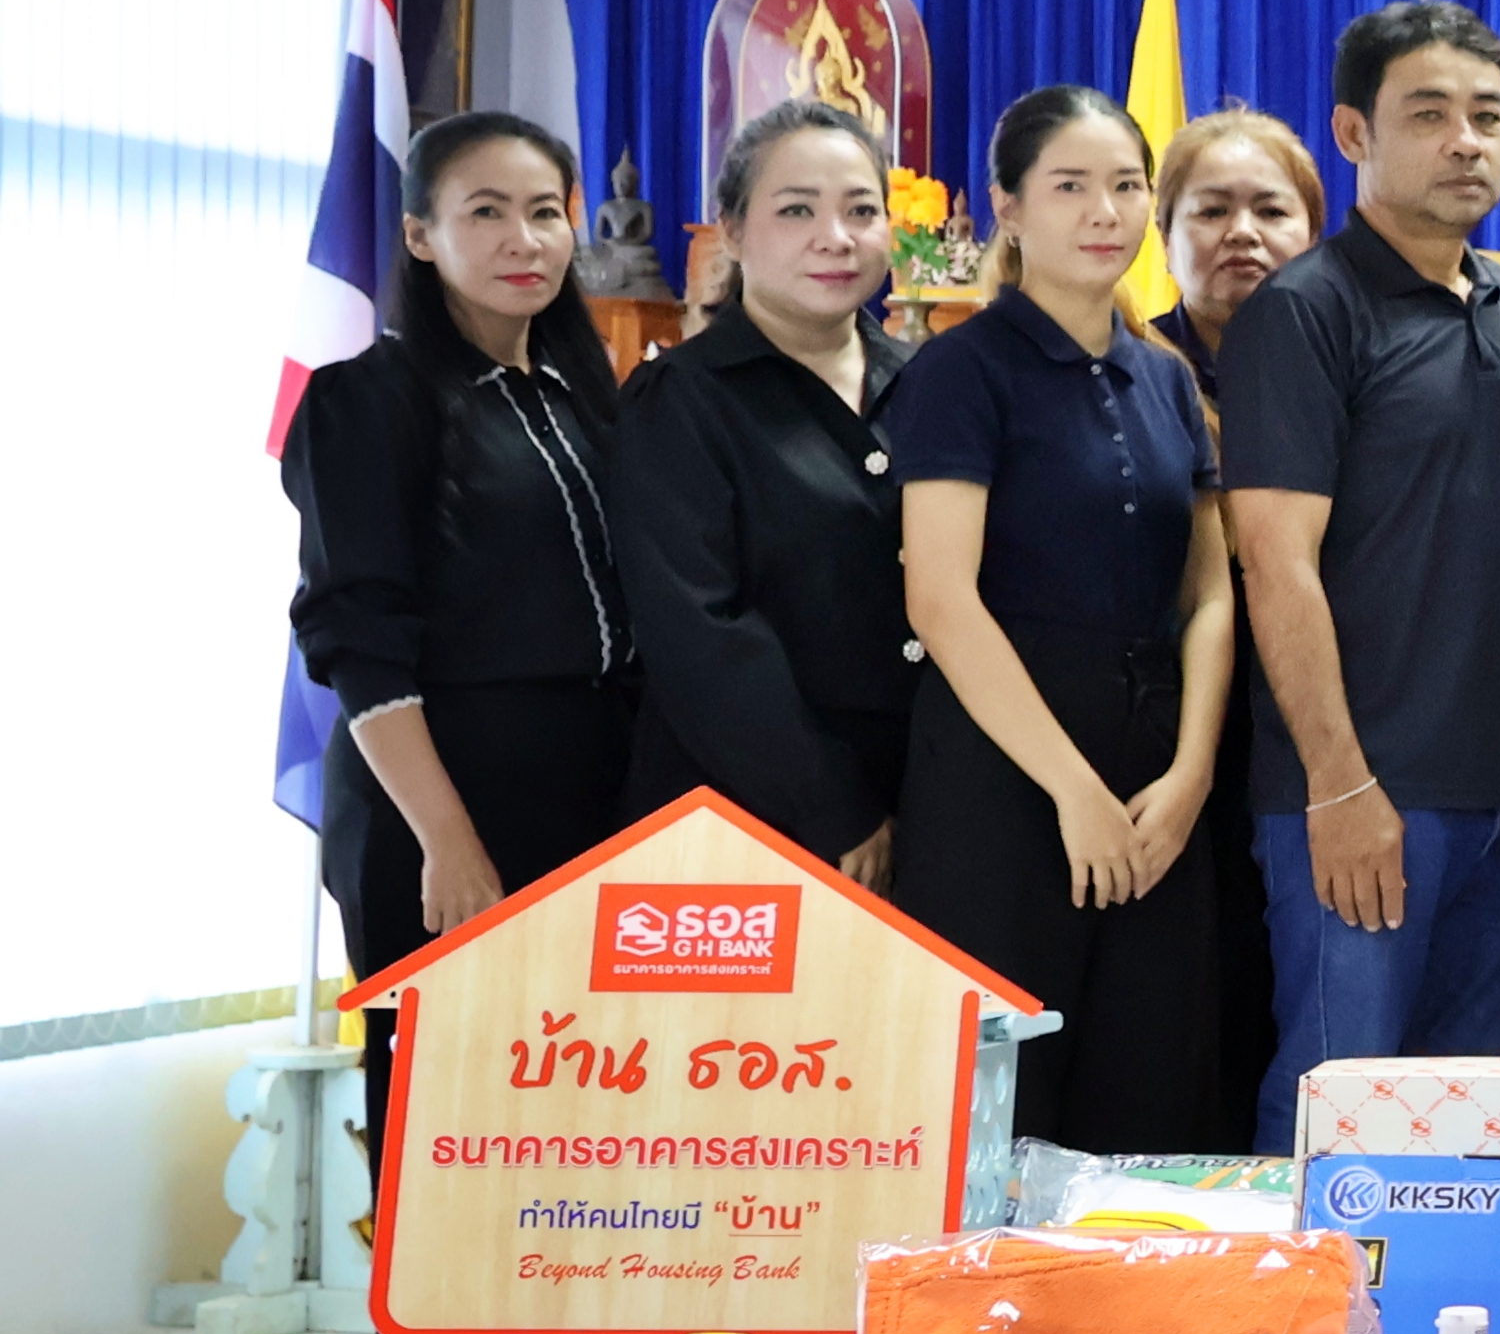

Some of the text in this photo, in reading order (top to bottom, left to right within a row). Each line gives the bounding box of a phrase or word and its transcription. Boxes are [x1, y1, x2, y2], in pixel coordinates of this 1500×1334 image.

[675, 903, 779, 939] ธอส
[718, 940, 775, 958] BANK
[509, 1011, 852, 1094] บ้าน ธอส.
[432, 1126, 924, 1169] ธนาคารอาคารสงเคราะห์
[518, 1195, 821, 1231] ทำให้คนไทยมี “บ้าน”
[518, 1252, 801, 1288] Beyond Housing Bank
